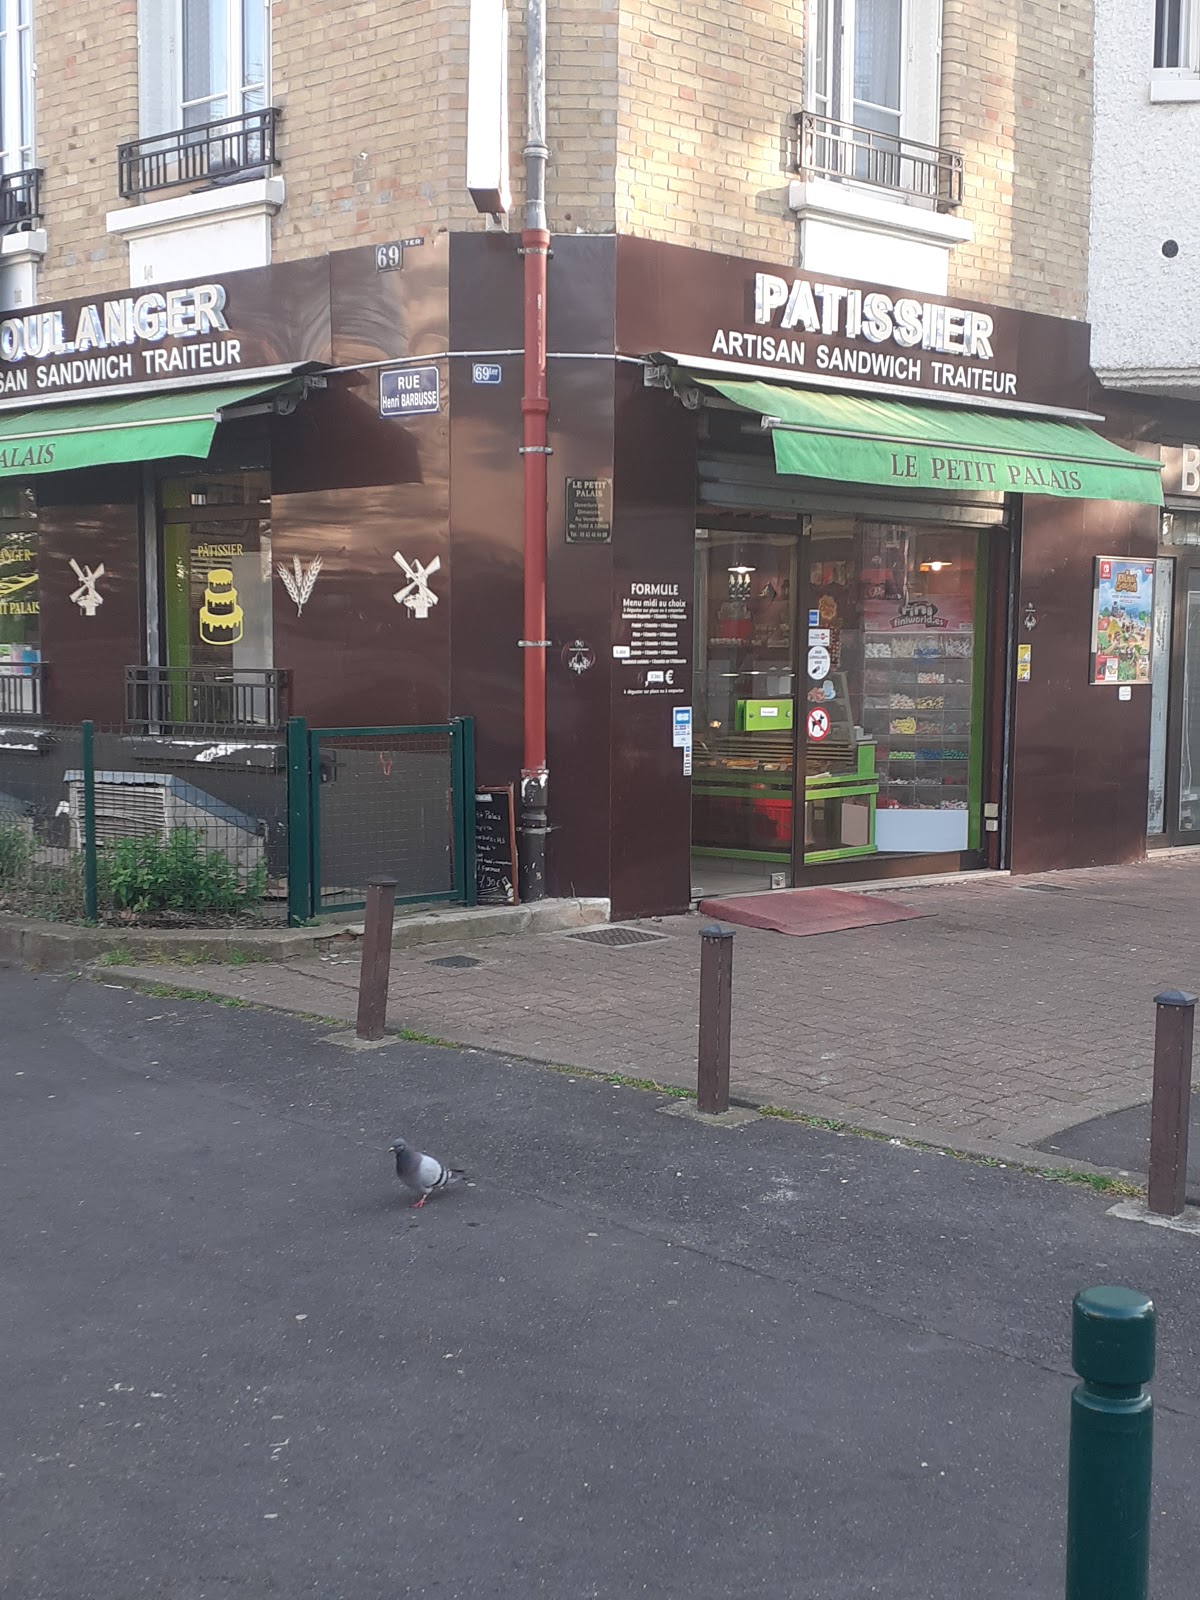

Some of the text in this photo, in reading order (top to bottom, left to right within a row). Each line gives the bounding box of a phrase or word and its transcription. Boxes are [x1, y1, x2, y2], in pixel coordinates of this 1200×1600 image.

[377, 245, 399, 267] 69
[755, 272, 994, 360] PATISSIER
[36, 353, 132, 388] SANDWICH
[142, 339, 241, 374] TRAITEUR
[712, 329, 1017, 395] ARTISAN SANDWICH TRAITEUR
[398, 375, 420, 390] RUE
[382, 391, 437, 409] Henri BARBUSSE
[891, 453, 1082, 491] LE PETIT PALAIS
[572, 481, 606, 490] LE PETIT
[197, 543, 244, 557] PÂTISSIER
[631, 583, 679, 596] FORMULE
[623, 598, 686, 607] Menu midi au choix
